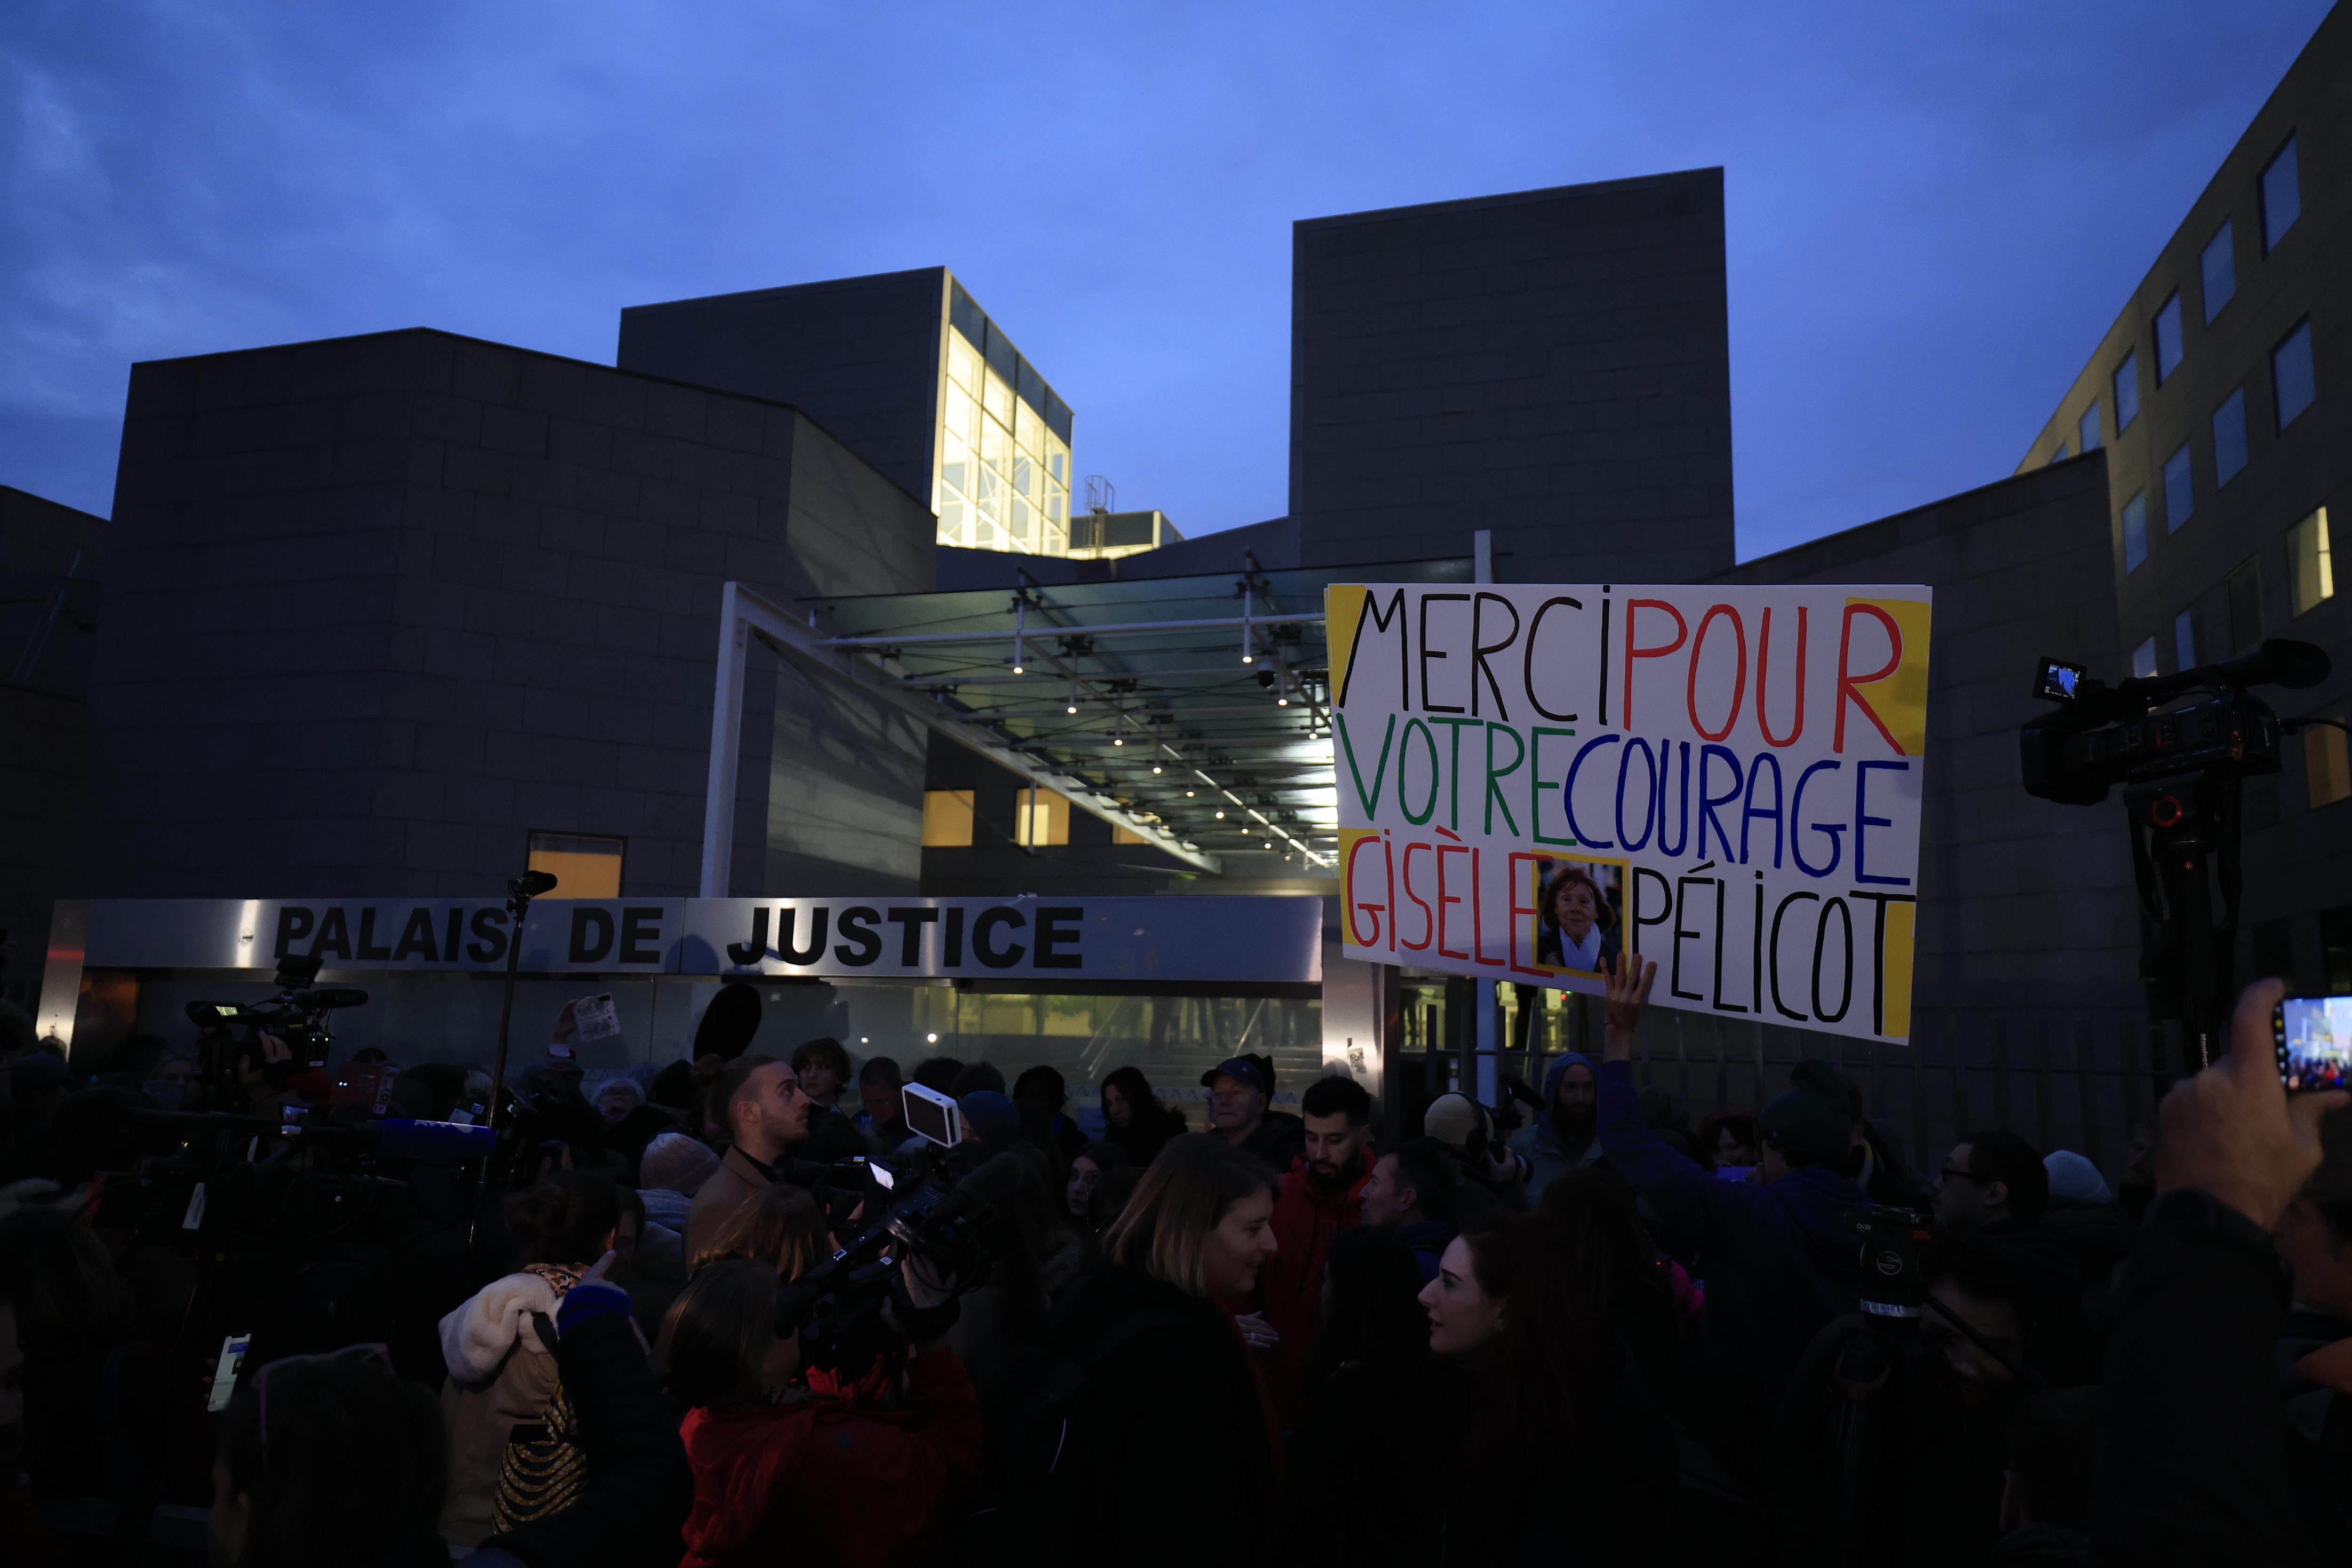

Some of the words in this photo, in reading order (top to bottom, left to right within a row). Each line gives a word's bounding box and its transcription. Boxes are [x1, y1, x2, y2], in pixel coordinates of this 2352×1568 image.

[1623, 598, 1906, 756] POUR
[1336, 713, 1576, 846] VOTRE
[1564, 733, 1911, 886] COURAGE
[274, 906, 509, 963] PALAIS
[568, 907, 664, 963] DE
[726, 906, 1084, 969] JUSTICE
